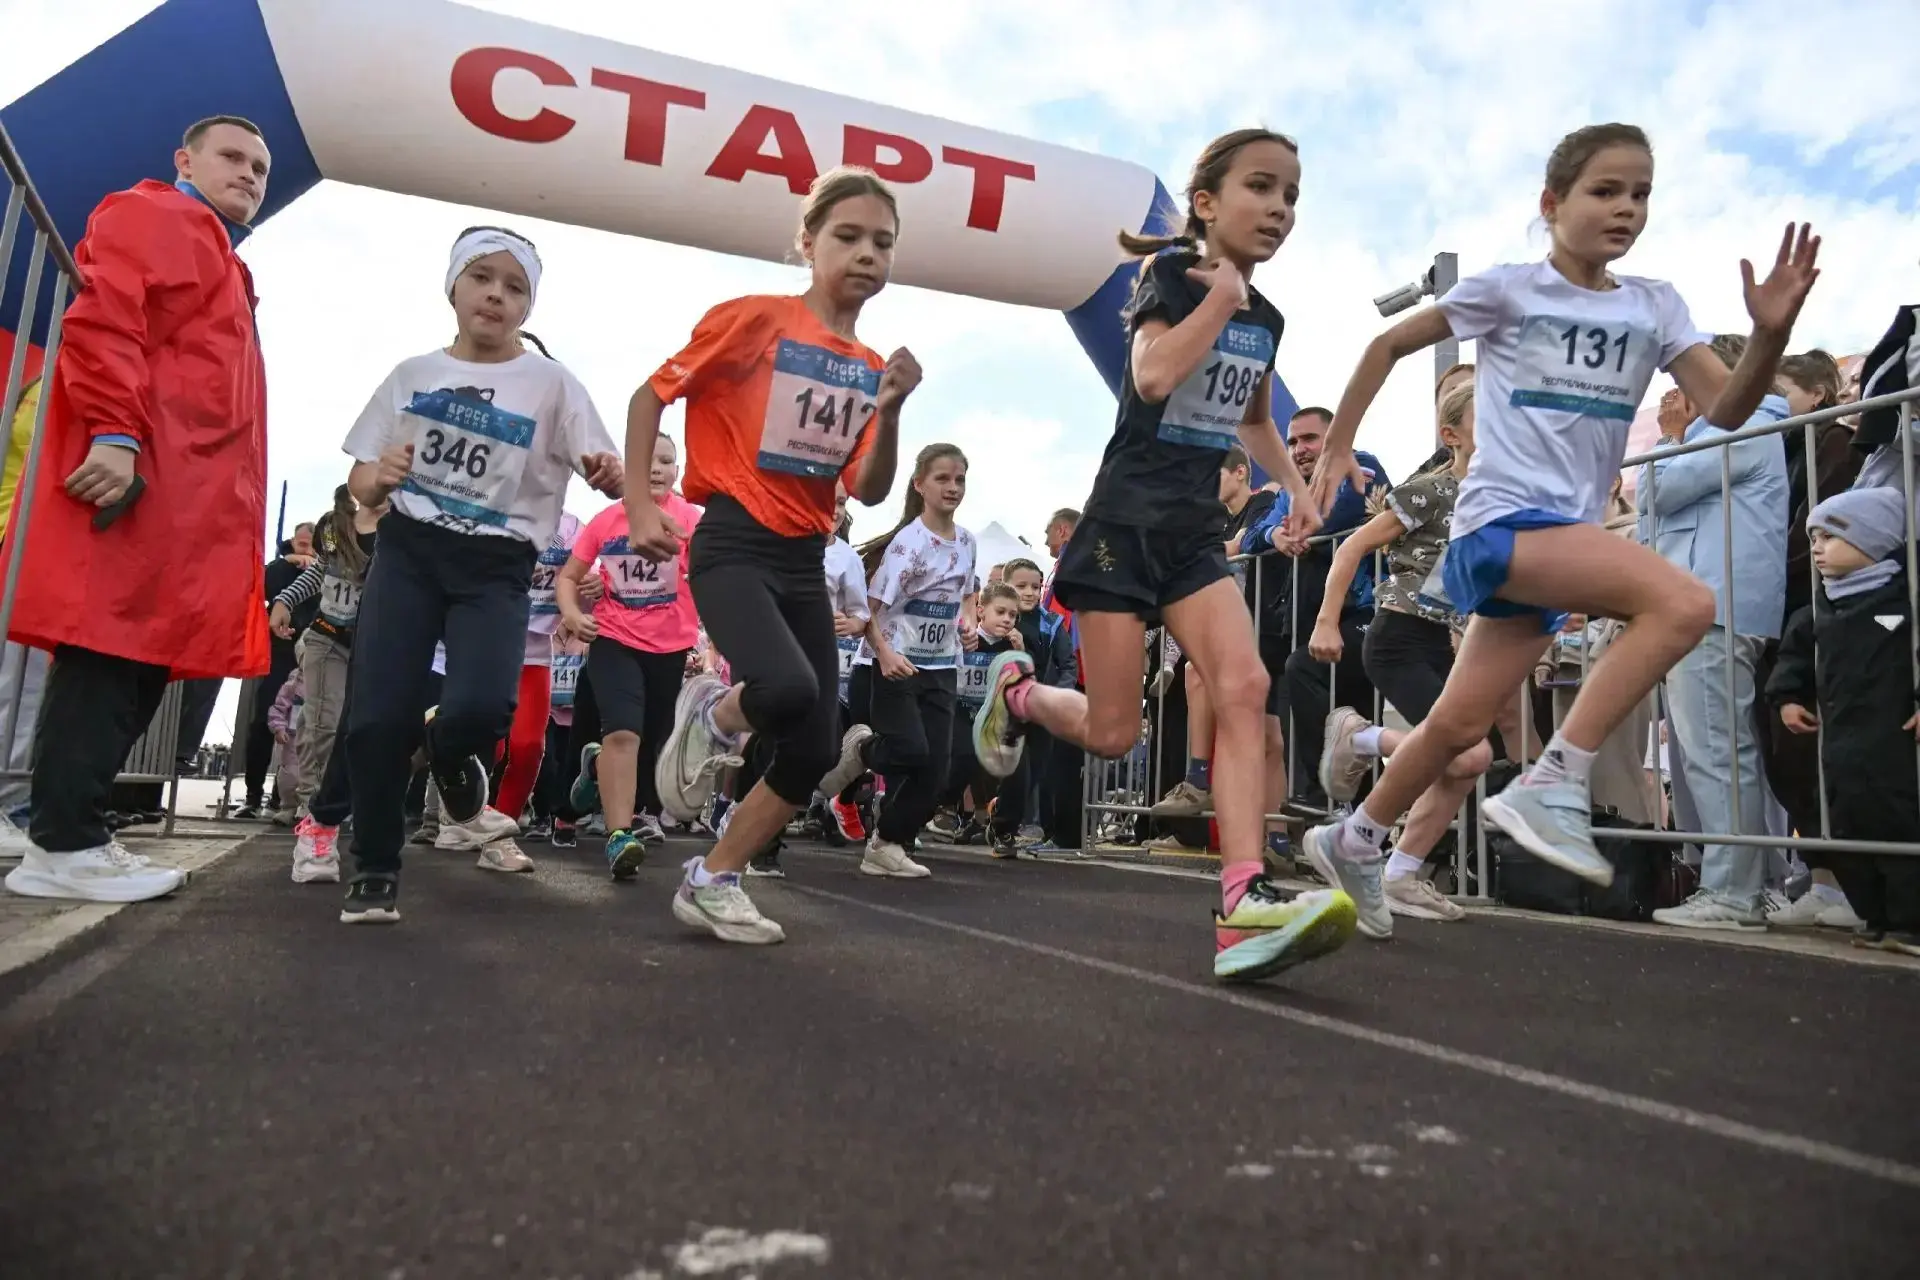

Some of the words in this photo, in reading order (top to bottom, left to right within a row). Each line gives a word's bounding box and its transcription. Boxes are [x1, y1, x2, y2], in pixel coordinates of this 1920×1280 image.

[450, 46, 1036, 232] СТАРТ
[1561, 325, 1630, 372] 131
[421, 429, 491, 478] 346
[618, 560, 659, 582] 142
[918, 622, 946, 644] 160
